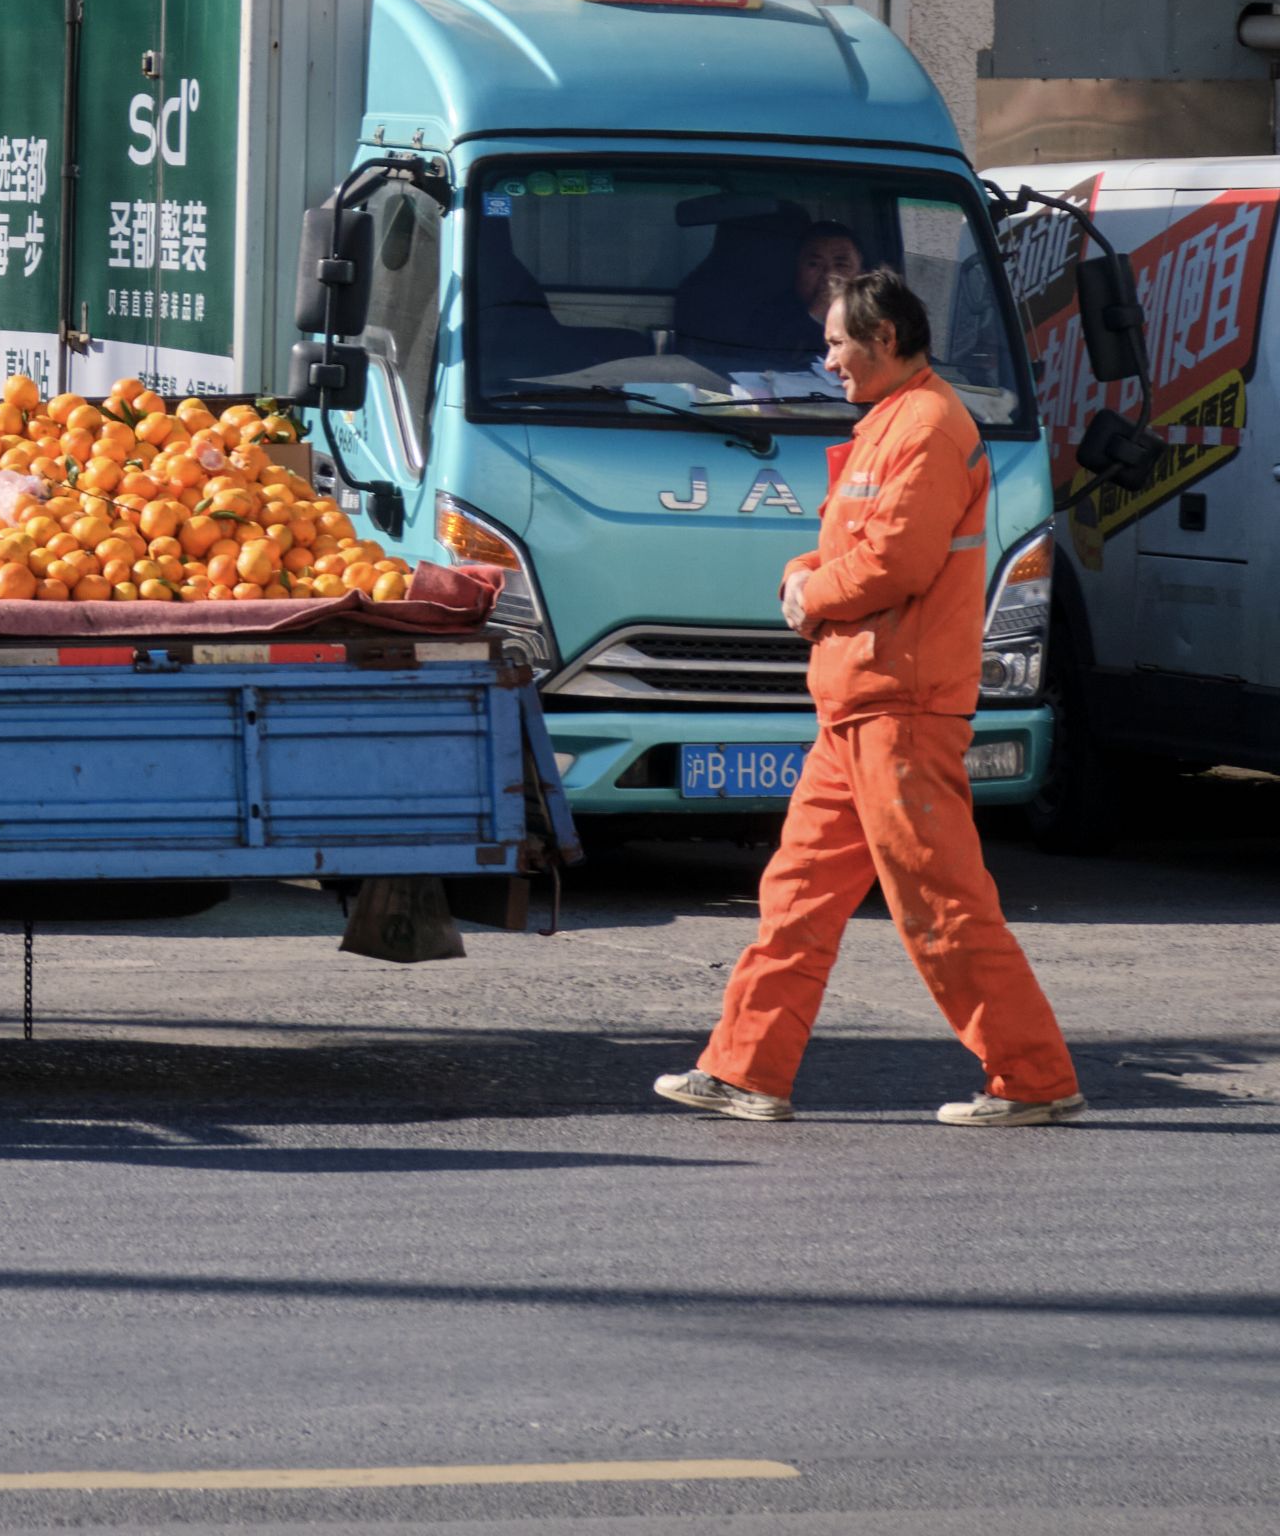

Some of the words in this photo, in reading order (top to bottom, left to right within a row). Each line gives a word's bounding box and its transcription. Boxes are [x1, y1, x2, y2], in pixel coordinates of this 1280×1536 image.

[108, 199, 207, 272] 圣都整装
[107, 289, 206, 322] 贝壳直营家装品牌
[658, 466, 804, 515] JA
[686, 752, 808, 789] 沪B·H86
